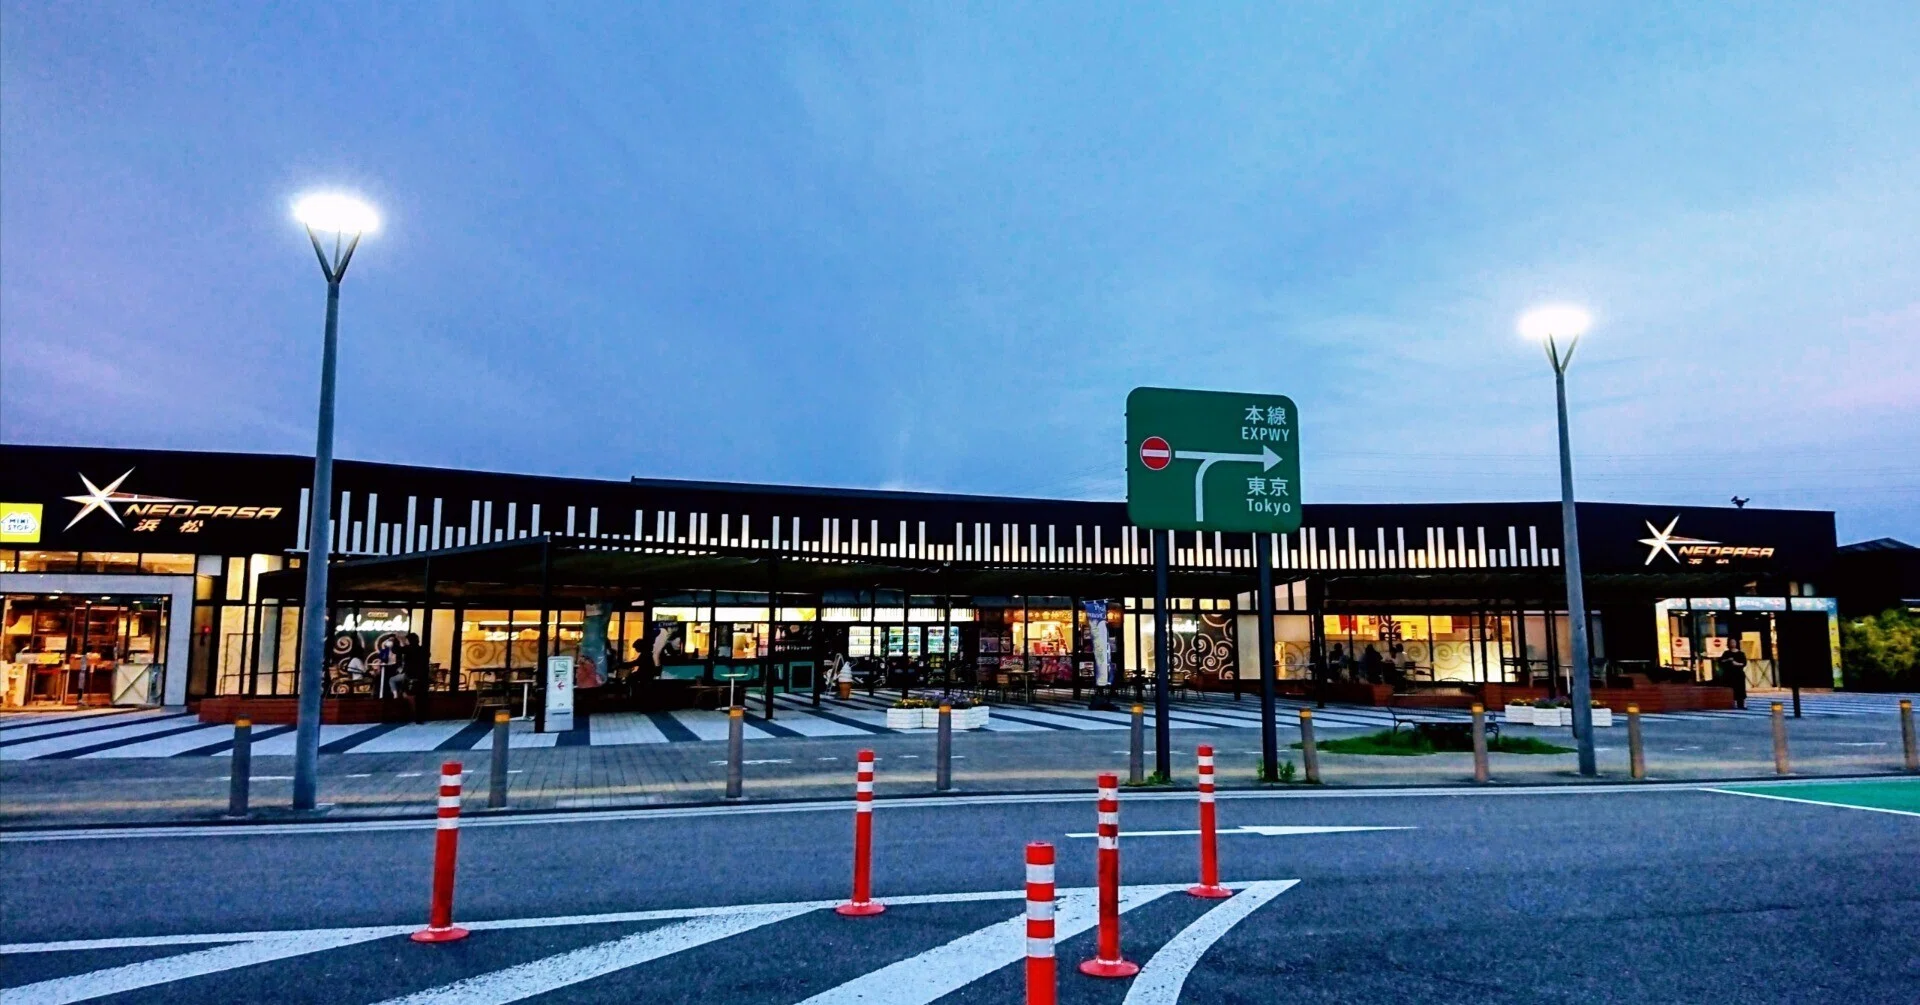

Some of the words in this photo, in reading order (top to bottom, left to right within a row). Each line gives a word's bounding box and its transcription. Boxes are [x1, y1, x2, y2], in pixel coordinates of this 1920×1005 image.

[1245, 405, 1286, 425] 本線
[1241, 426, 1290, 442] EXPWY
[1246, 476, 1289, 497] 東京
[123, 503, 282, 520] NEOPASA
[1246, 498, 1290, 516] Tokyo
[133, 518, 203, 533] 浜松
[1679, 545, 1774, 557] NEOPASA
